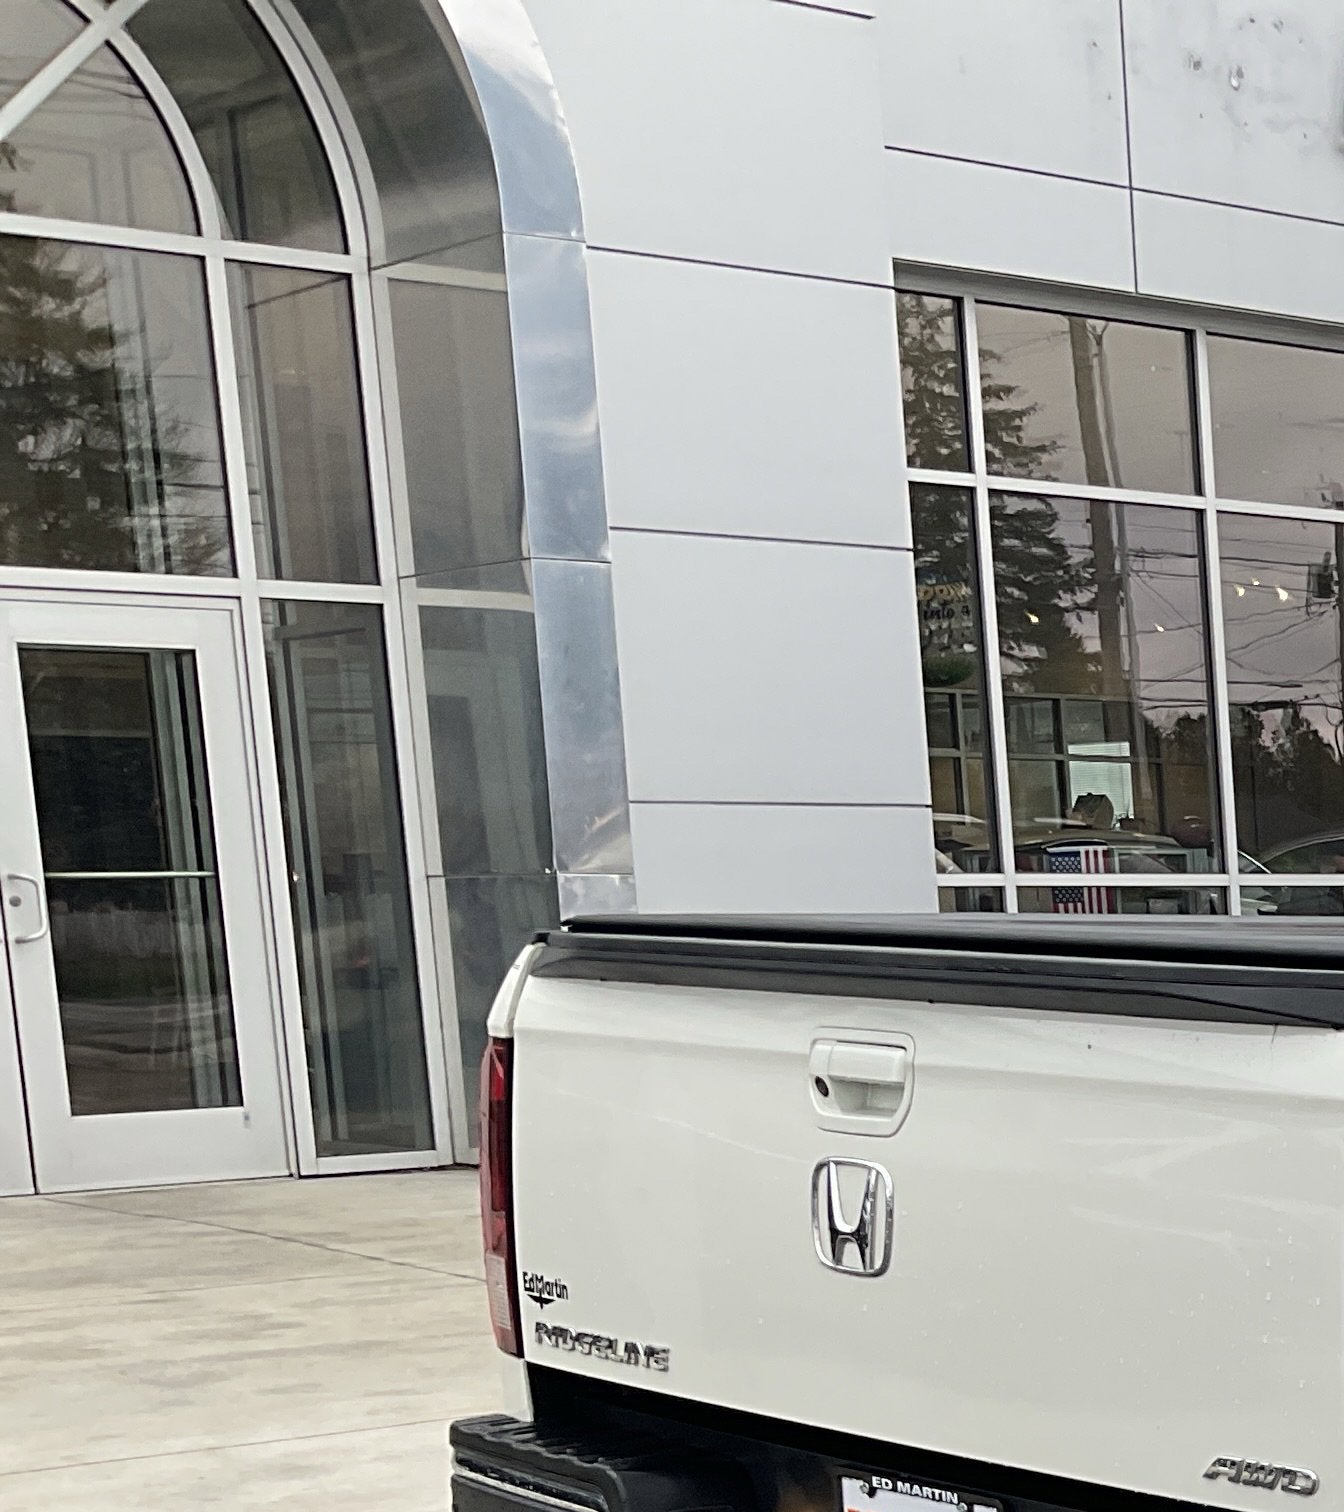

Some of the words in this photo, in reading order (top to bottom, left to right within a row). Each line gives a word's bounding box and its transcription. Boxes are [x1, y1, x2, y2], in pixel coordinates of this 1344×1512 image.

[522, 1271, 568, 1302] EdMartin
[534, 1321, 670, 1372] RIDGELINE
[871, 1475, 893, 1491] ED
[896, 1480, 959, 1505] MARTIN
[1203, 1455, 1320, 1496] AWD
